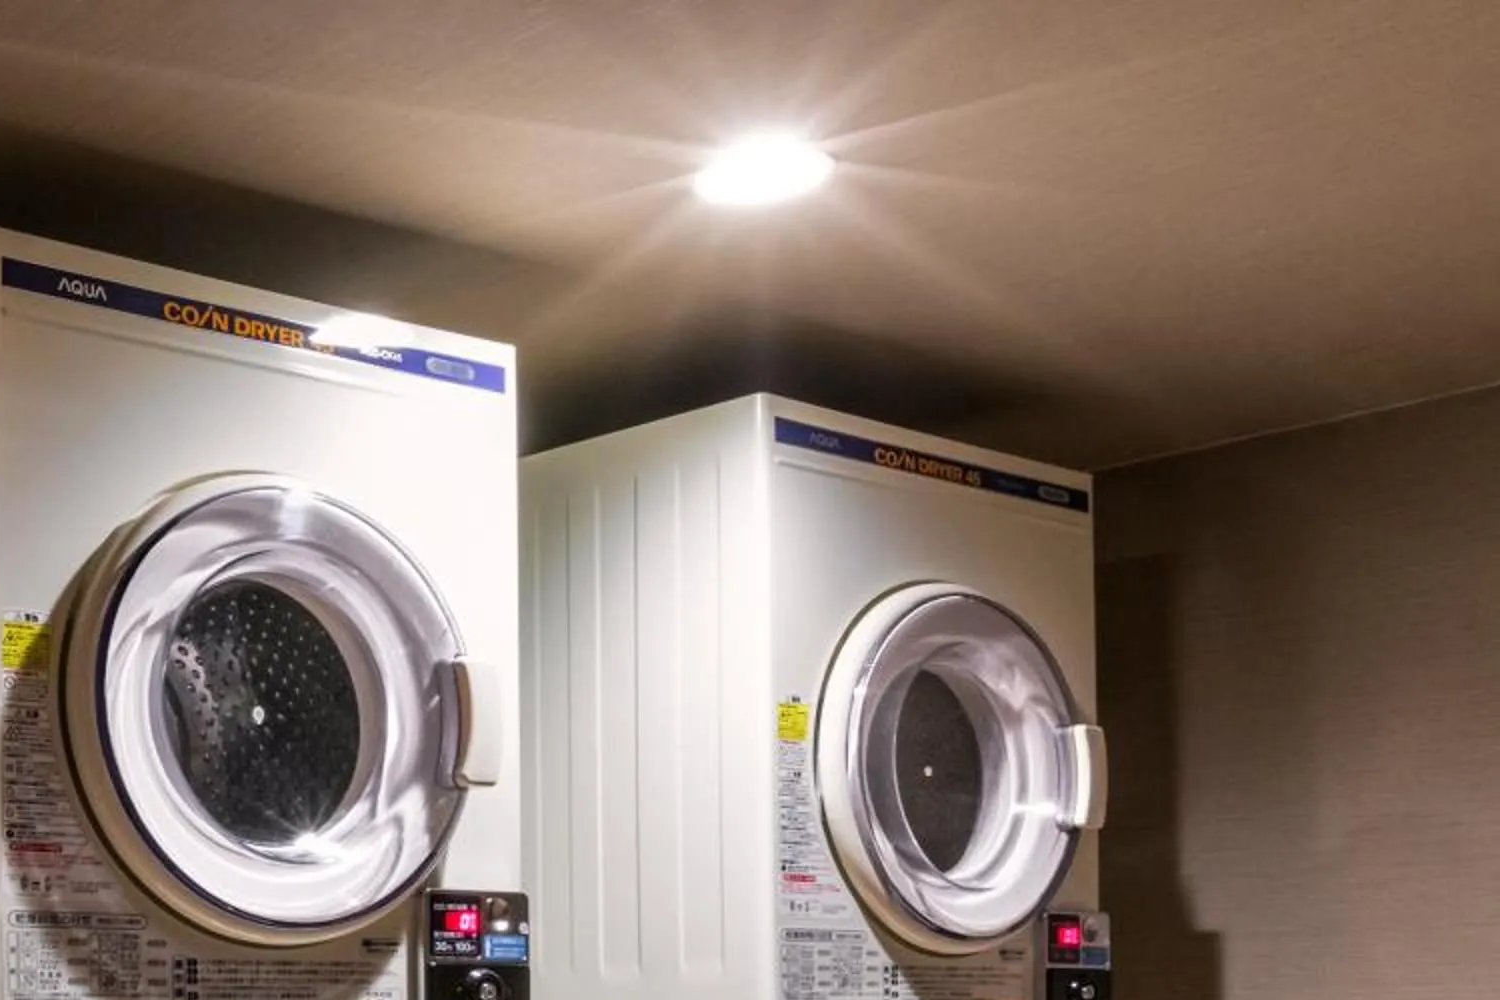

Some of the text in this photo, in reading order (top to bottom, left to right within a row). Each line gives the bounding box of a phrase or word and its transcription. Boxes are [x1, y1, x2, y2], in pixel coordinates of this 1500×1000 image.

[57, 276, 108, 301] AQUA
[234, 317, 303, 349] DRYER
[918, 457, 963, 482] DRYER
[965, 469, 981, 487] 45
